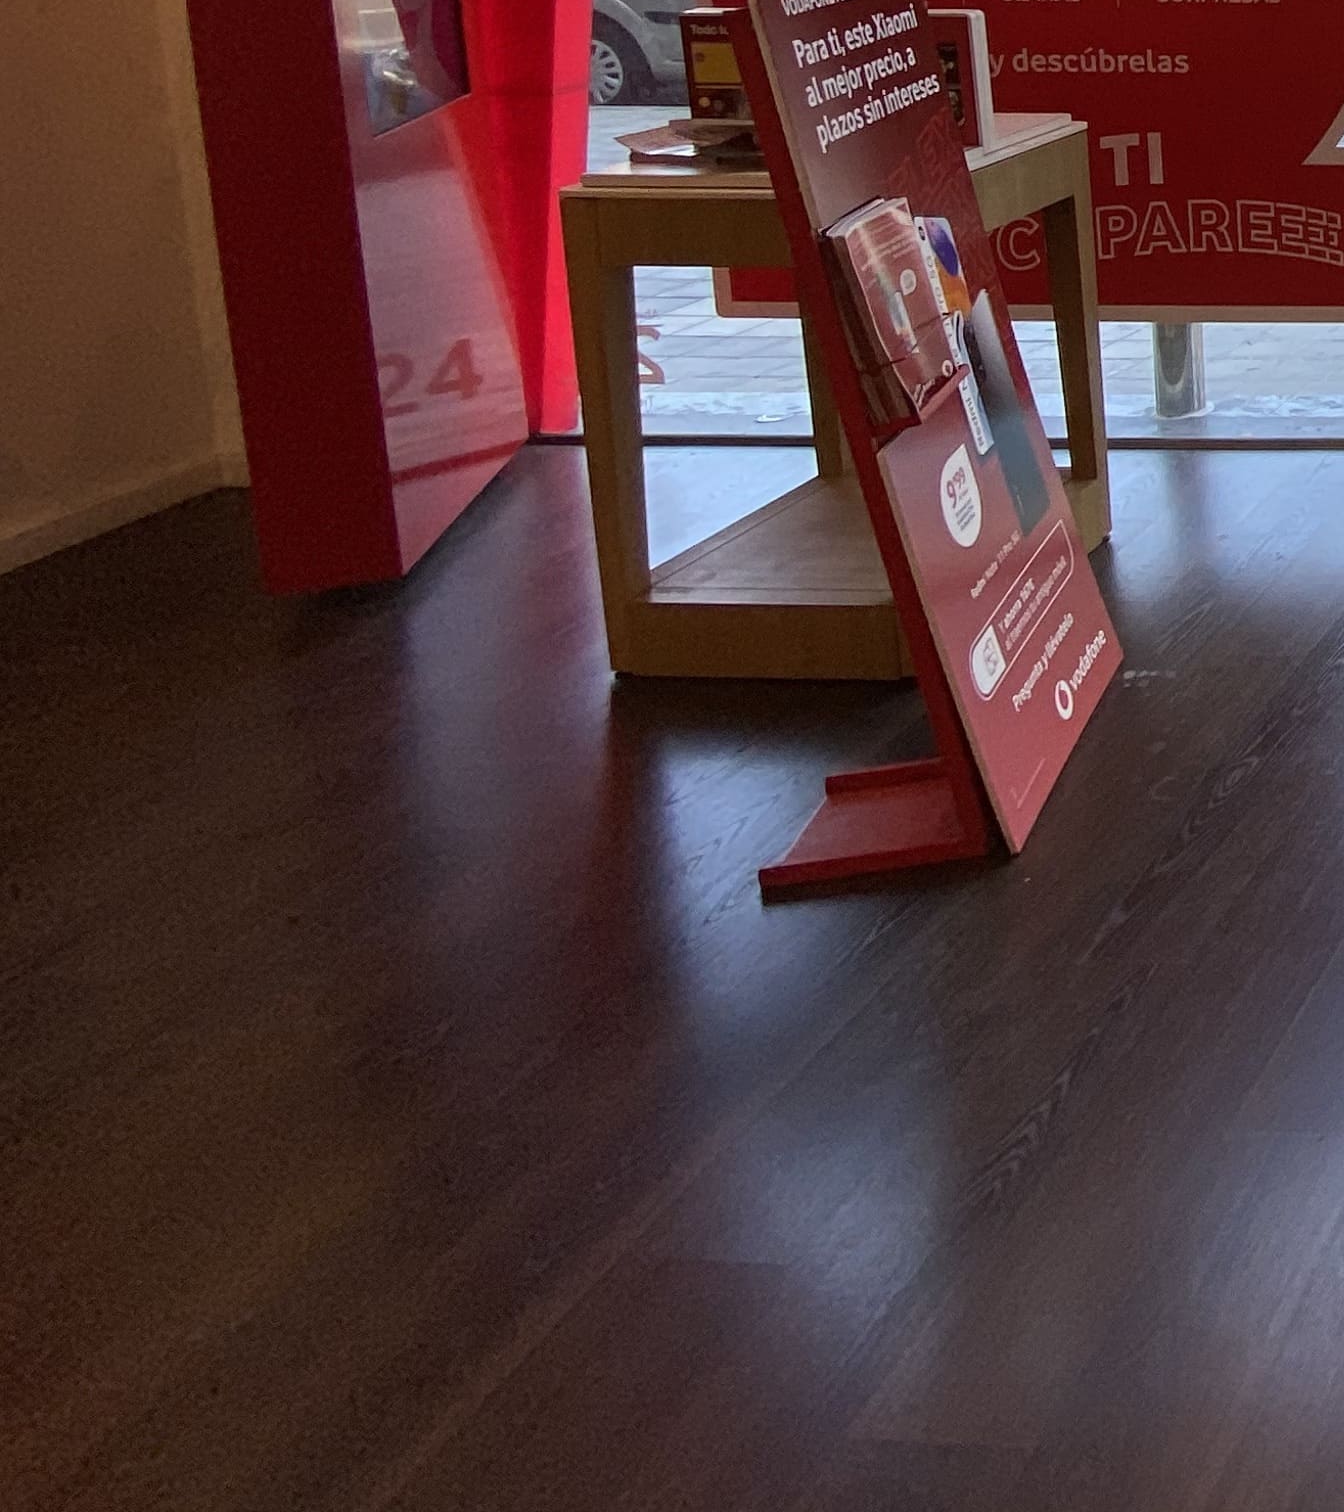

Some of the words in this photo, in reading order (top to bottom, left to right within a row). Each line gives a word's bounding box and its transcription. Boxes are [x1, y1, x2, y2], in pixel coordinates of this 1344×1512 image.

[793, 35, 827, 67] Para
[828, 29, 846, 57] ti,
[846, 24, 874, 50] este
[874, 3, 918, 39] Xiaomi
[989, 55, 1006, 79] y
[1012, 46, 1190, 74] descúbrelas
[805, 82, 823, 108] al
[823, 63, 864, 102] mejor
[865, 51, 908, 91] precio,
[906, 46, 917, 66] a
[816, 105, 865, 153] plazos
[864, 96, 886, 125] sin
[883, 73, 940, 117] intereses
[1100, 132, 1164, 186] TI
[1068, 630, 1107, 691] vodafone
